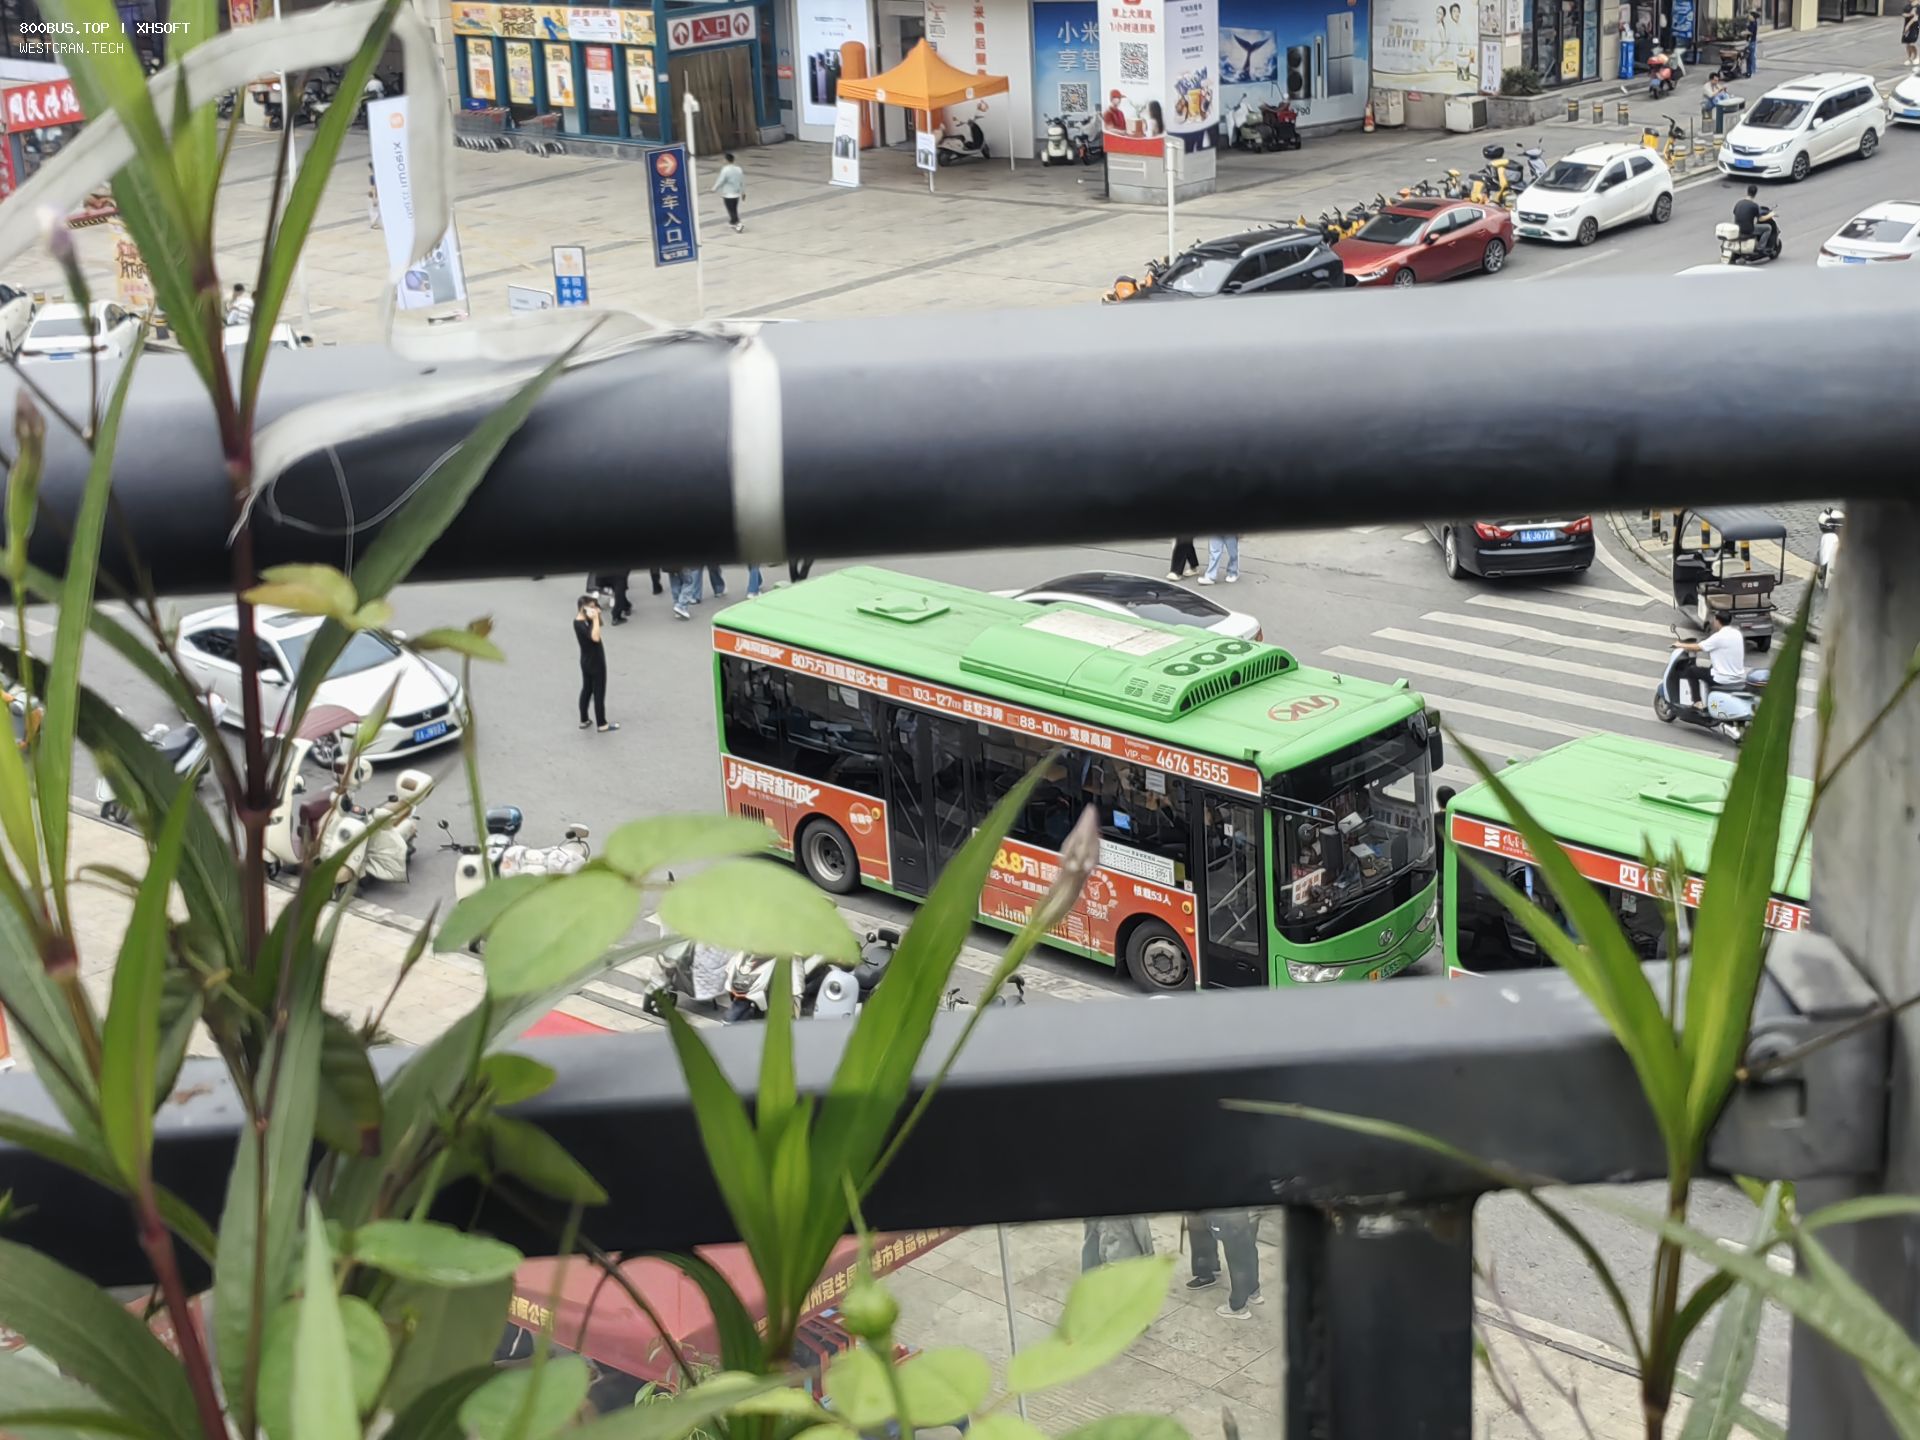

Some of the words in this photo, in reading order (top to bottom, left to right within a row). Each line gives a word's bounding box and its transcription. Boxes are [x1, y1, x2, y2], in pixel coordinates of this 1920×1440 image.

[697, 18, 727, 37] 入口
[1057, 20, 1099, 44] 小米
[1057, 49, 1099, 73] 享智
[659, 177, 683, 243] 汽车入口
[1156, 749, 1190, 774] 4676
[1193, 758, 1230, 785] 5555
